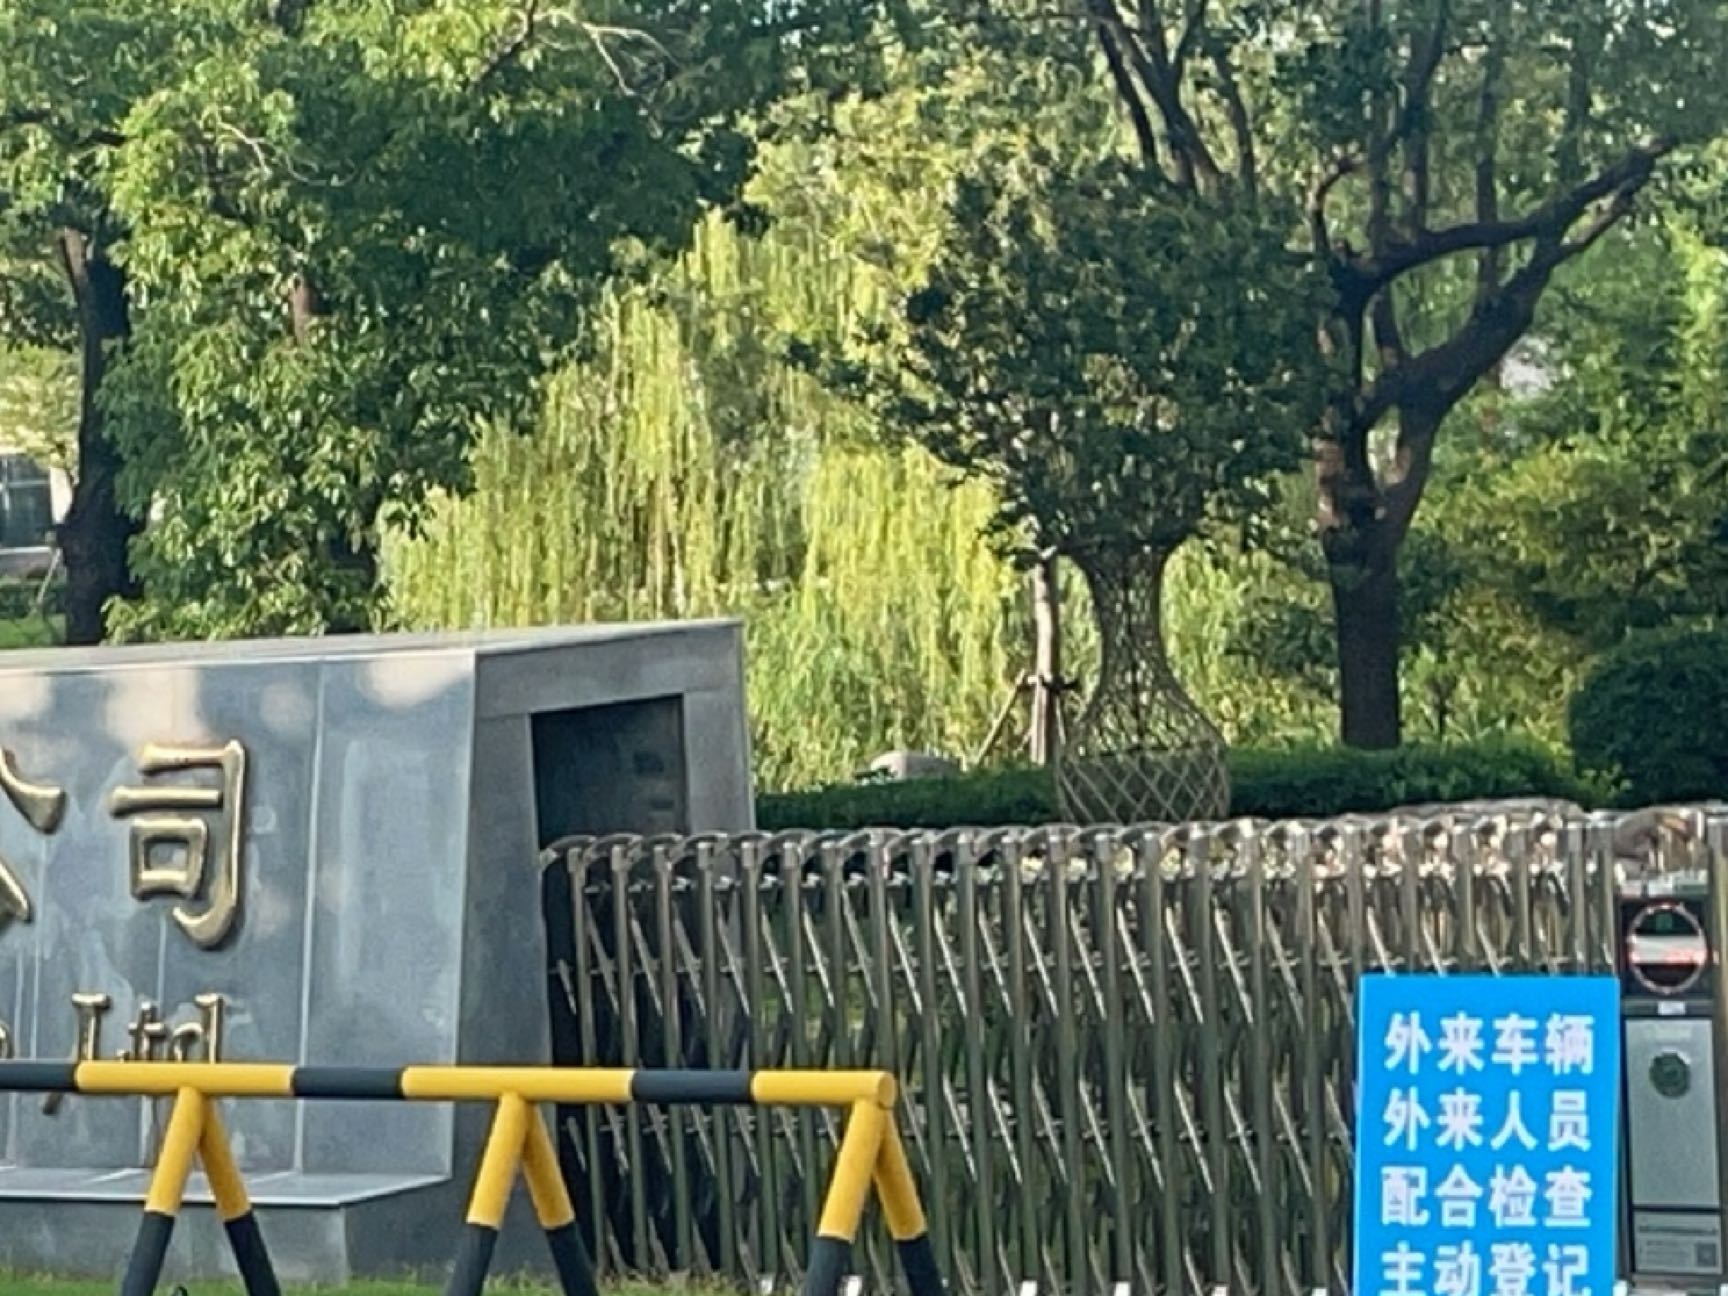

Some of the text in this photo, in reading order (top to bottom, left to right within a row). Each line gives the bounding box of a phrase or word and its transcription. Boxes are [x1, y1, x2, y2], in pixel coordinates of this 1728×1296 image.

[1383, 1011, 1595, 1075] 外来车辆
[1382, 1087, 1593, 1152] 外来人员
[1380, 1164, 1593, 1228] 配合检查
